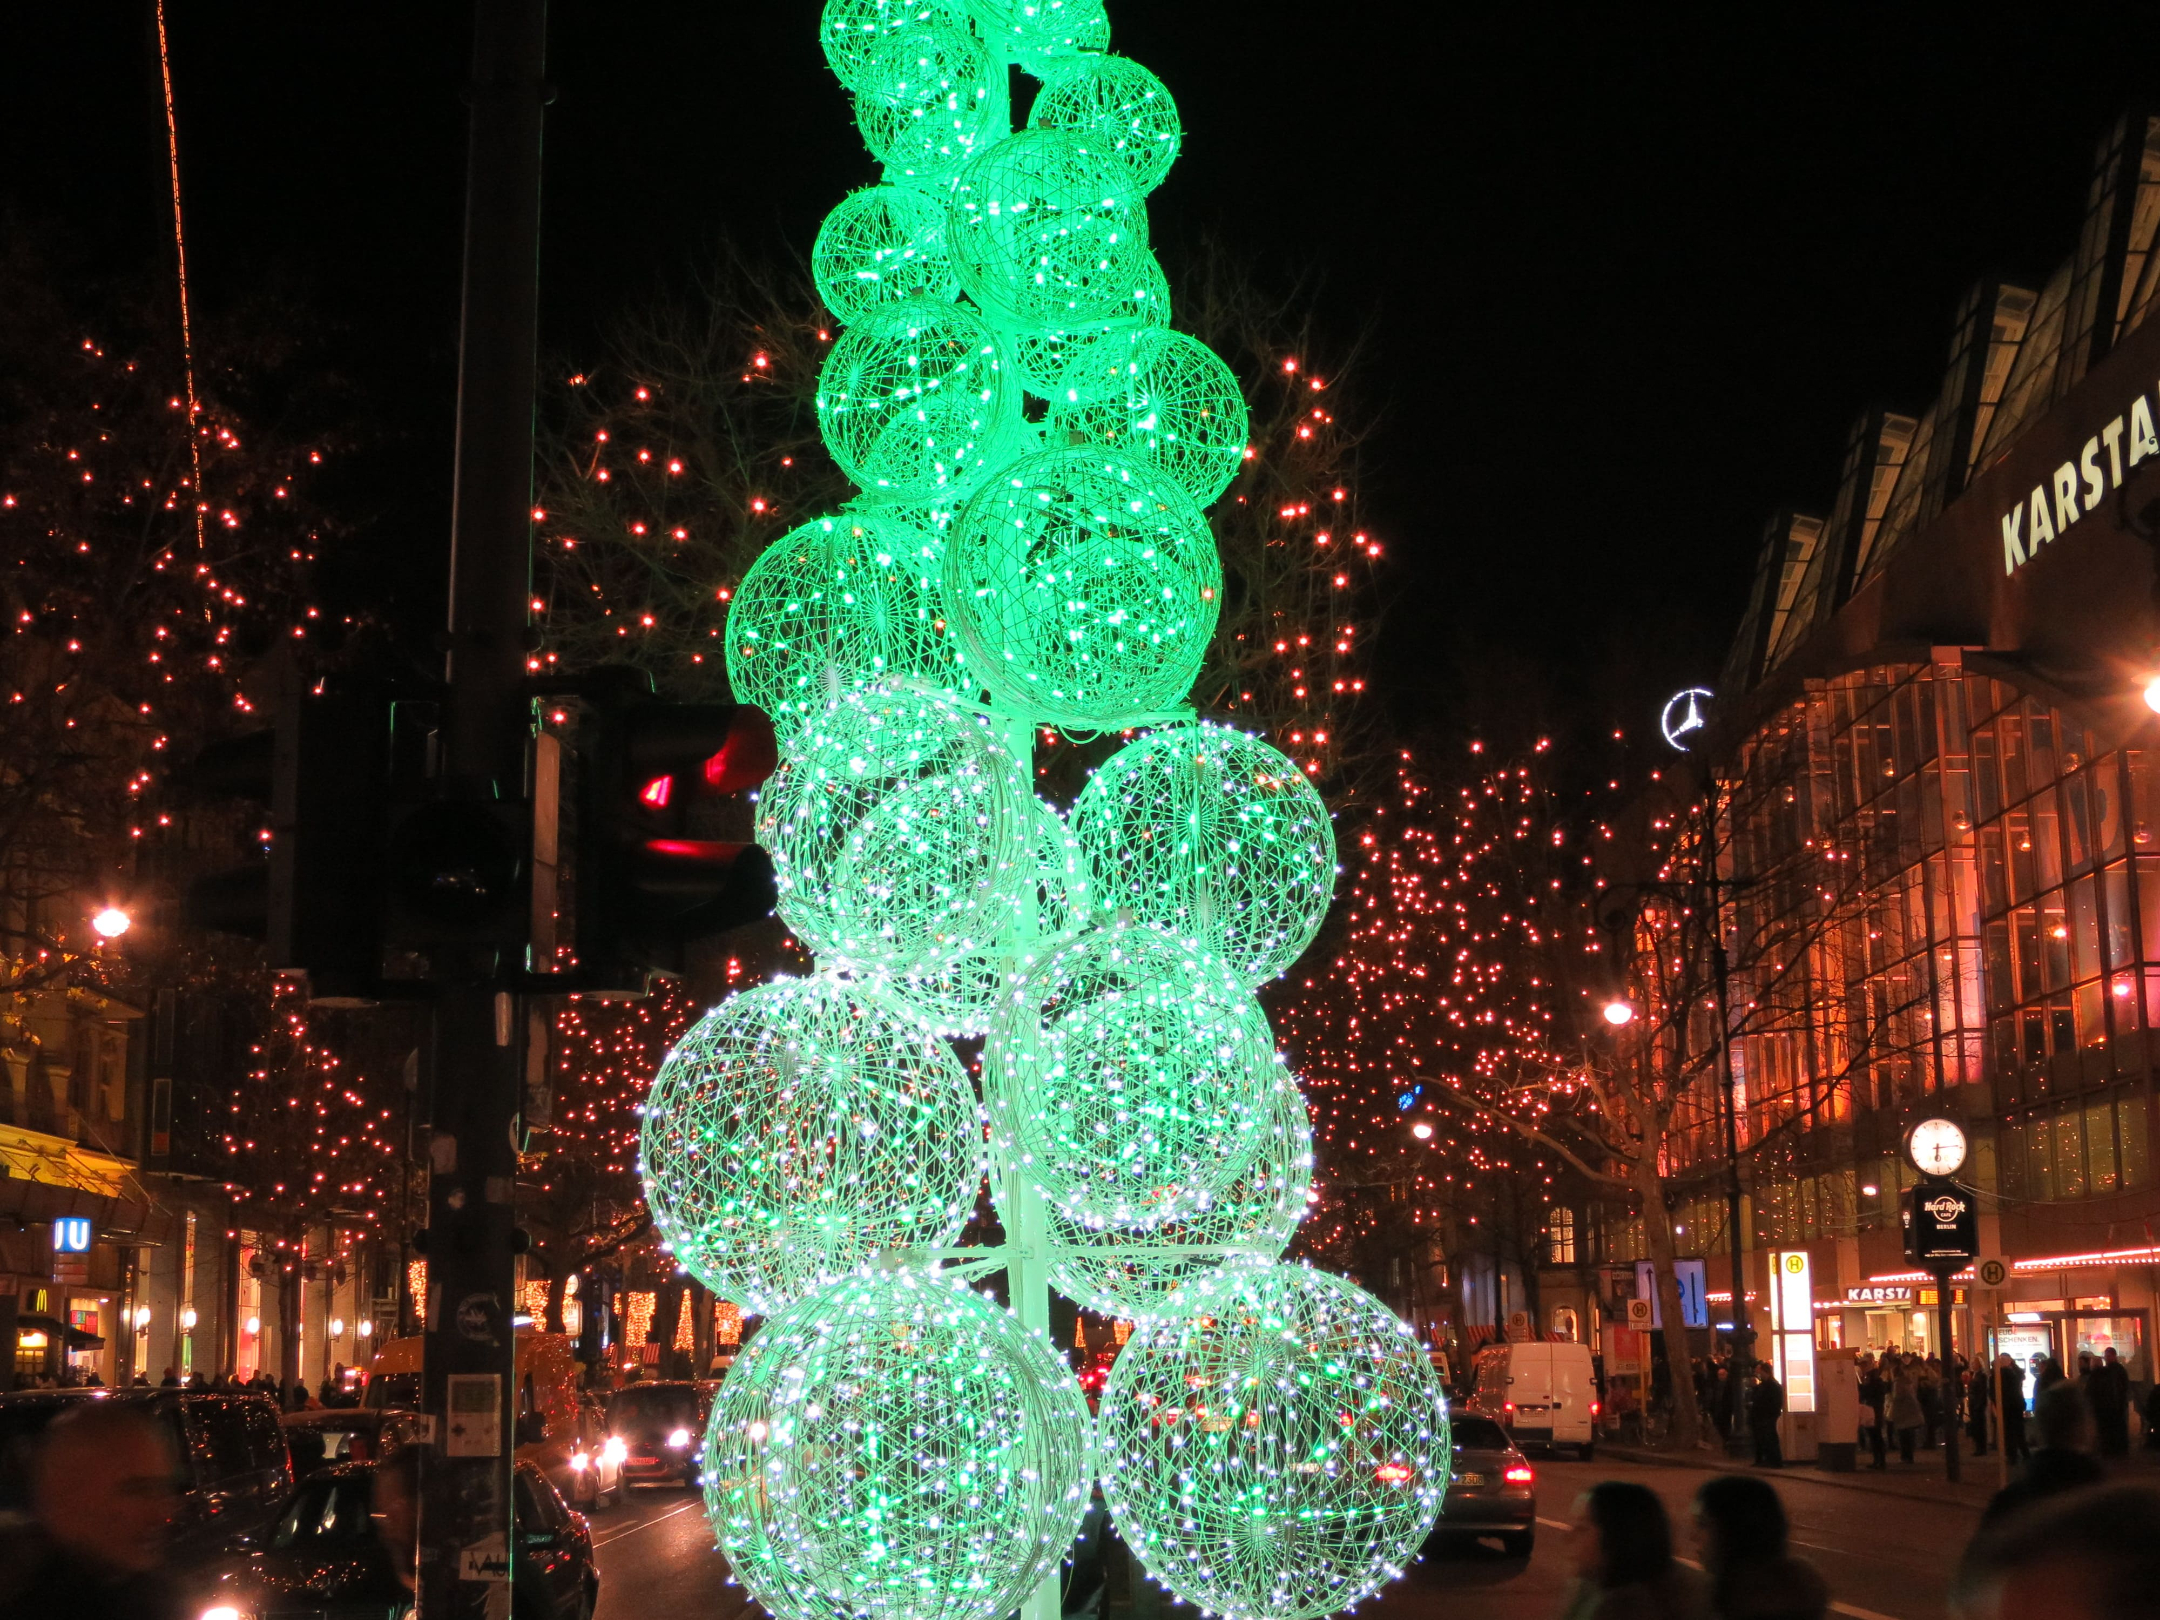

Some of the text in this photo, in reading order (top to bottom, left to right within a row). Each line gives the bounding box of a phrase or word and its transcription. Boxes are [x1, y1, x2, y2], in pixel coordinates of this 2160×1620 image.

[2002, 380, 2160, 576] KARSTA
[1924, 1201, 1965, 1213] Hard Rock
[70, 1221, 88, 1250] U
